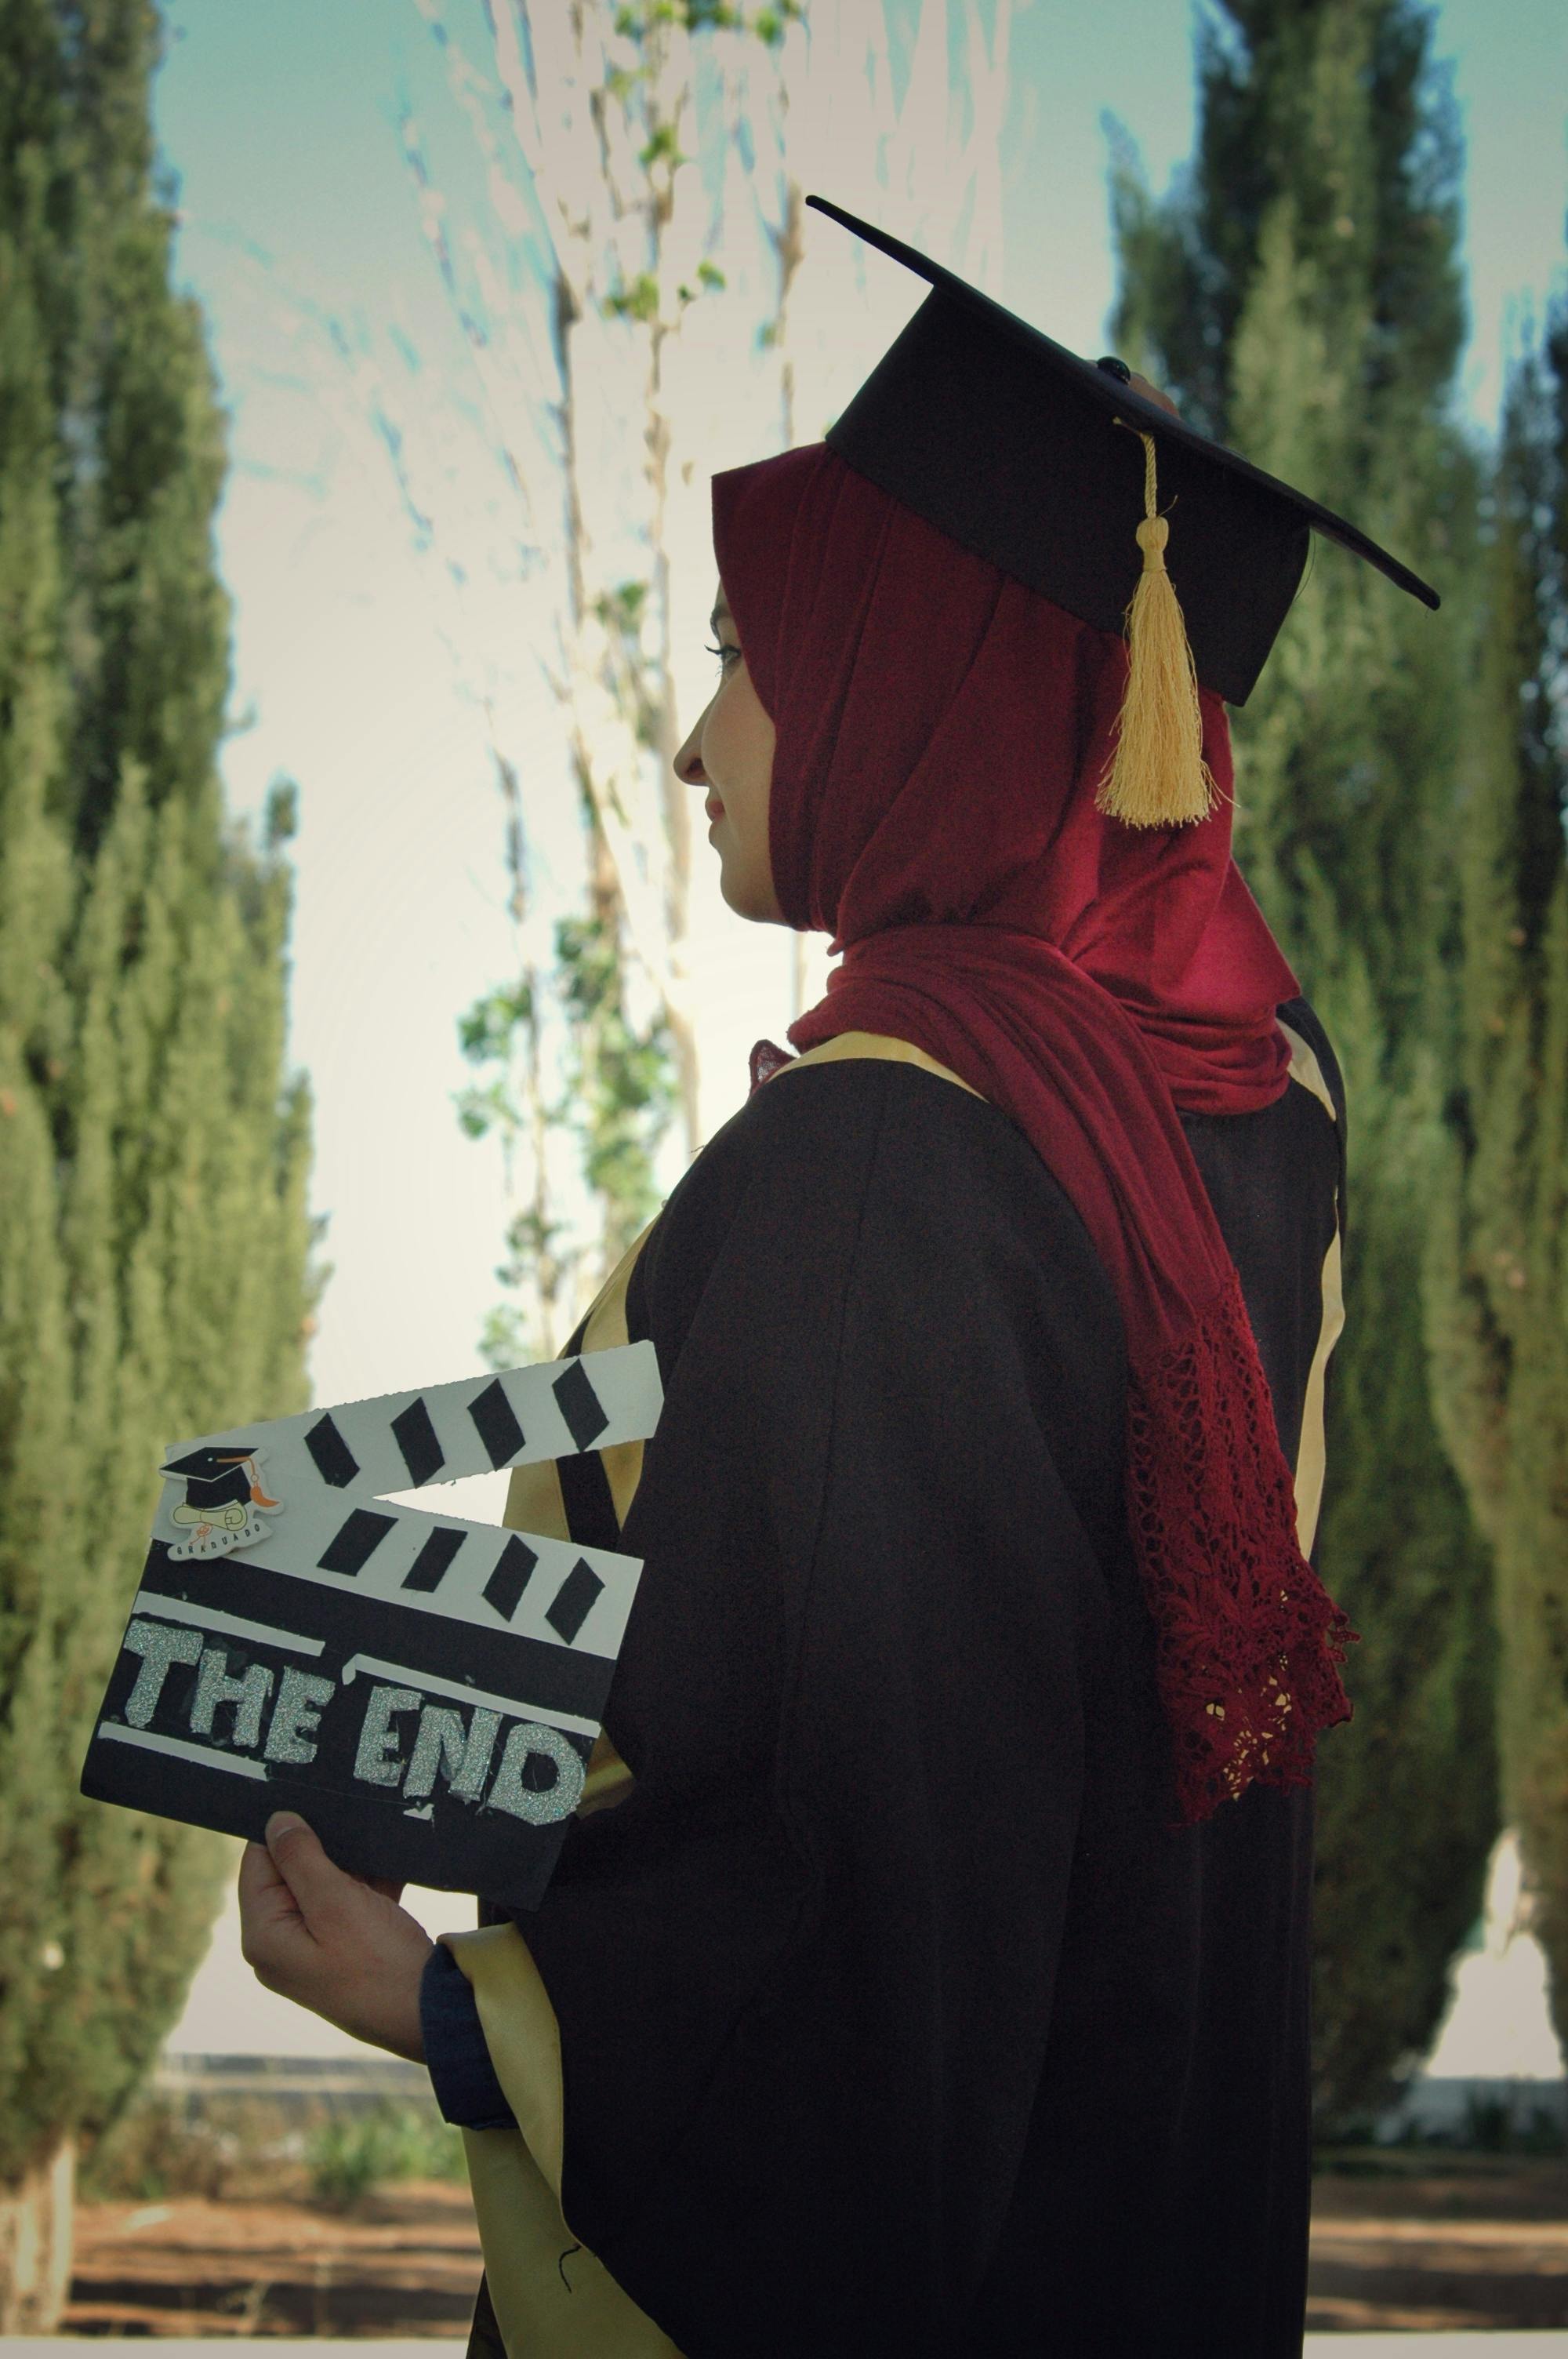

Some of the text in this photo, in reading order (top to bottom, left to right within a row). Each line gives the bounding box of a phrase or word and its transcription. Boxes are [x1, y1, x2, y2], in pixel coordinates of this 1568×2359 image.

[176, 1524, 260, 1555] GRADUADO
[123, 1619, 586, 1826] THE END
